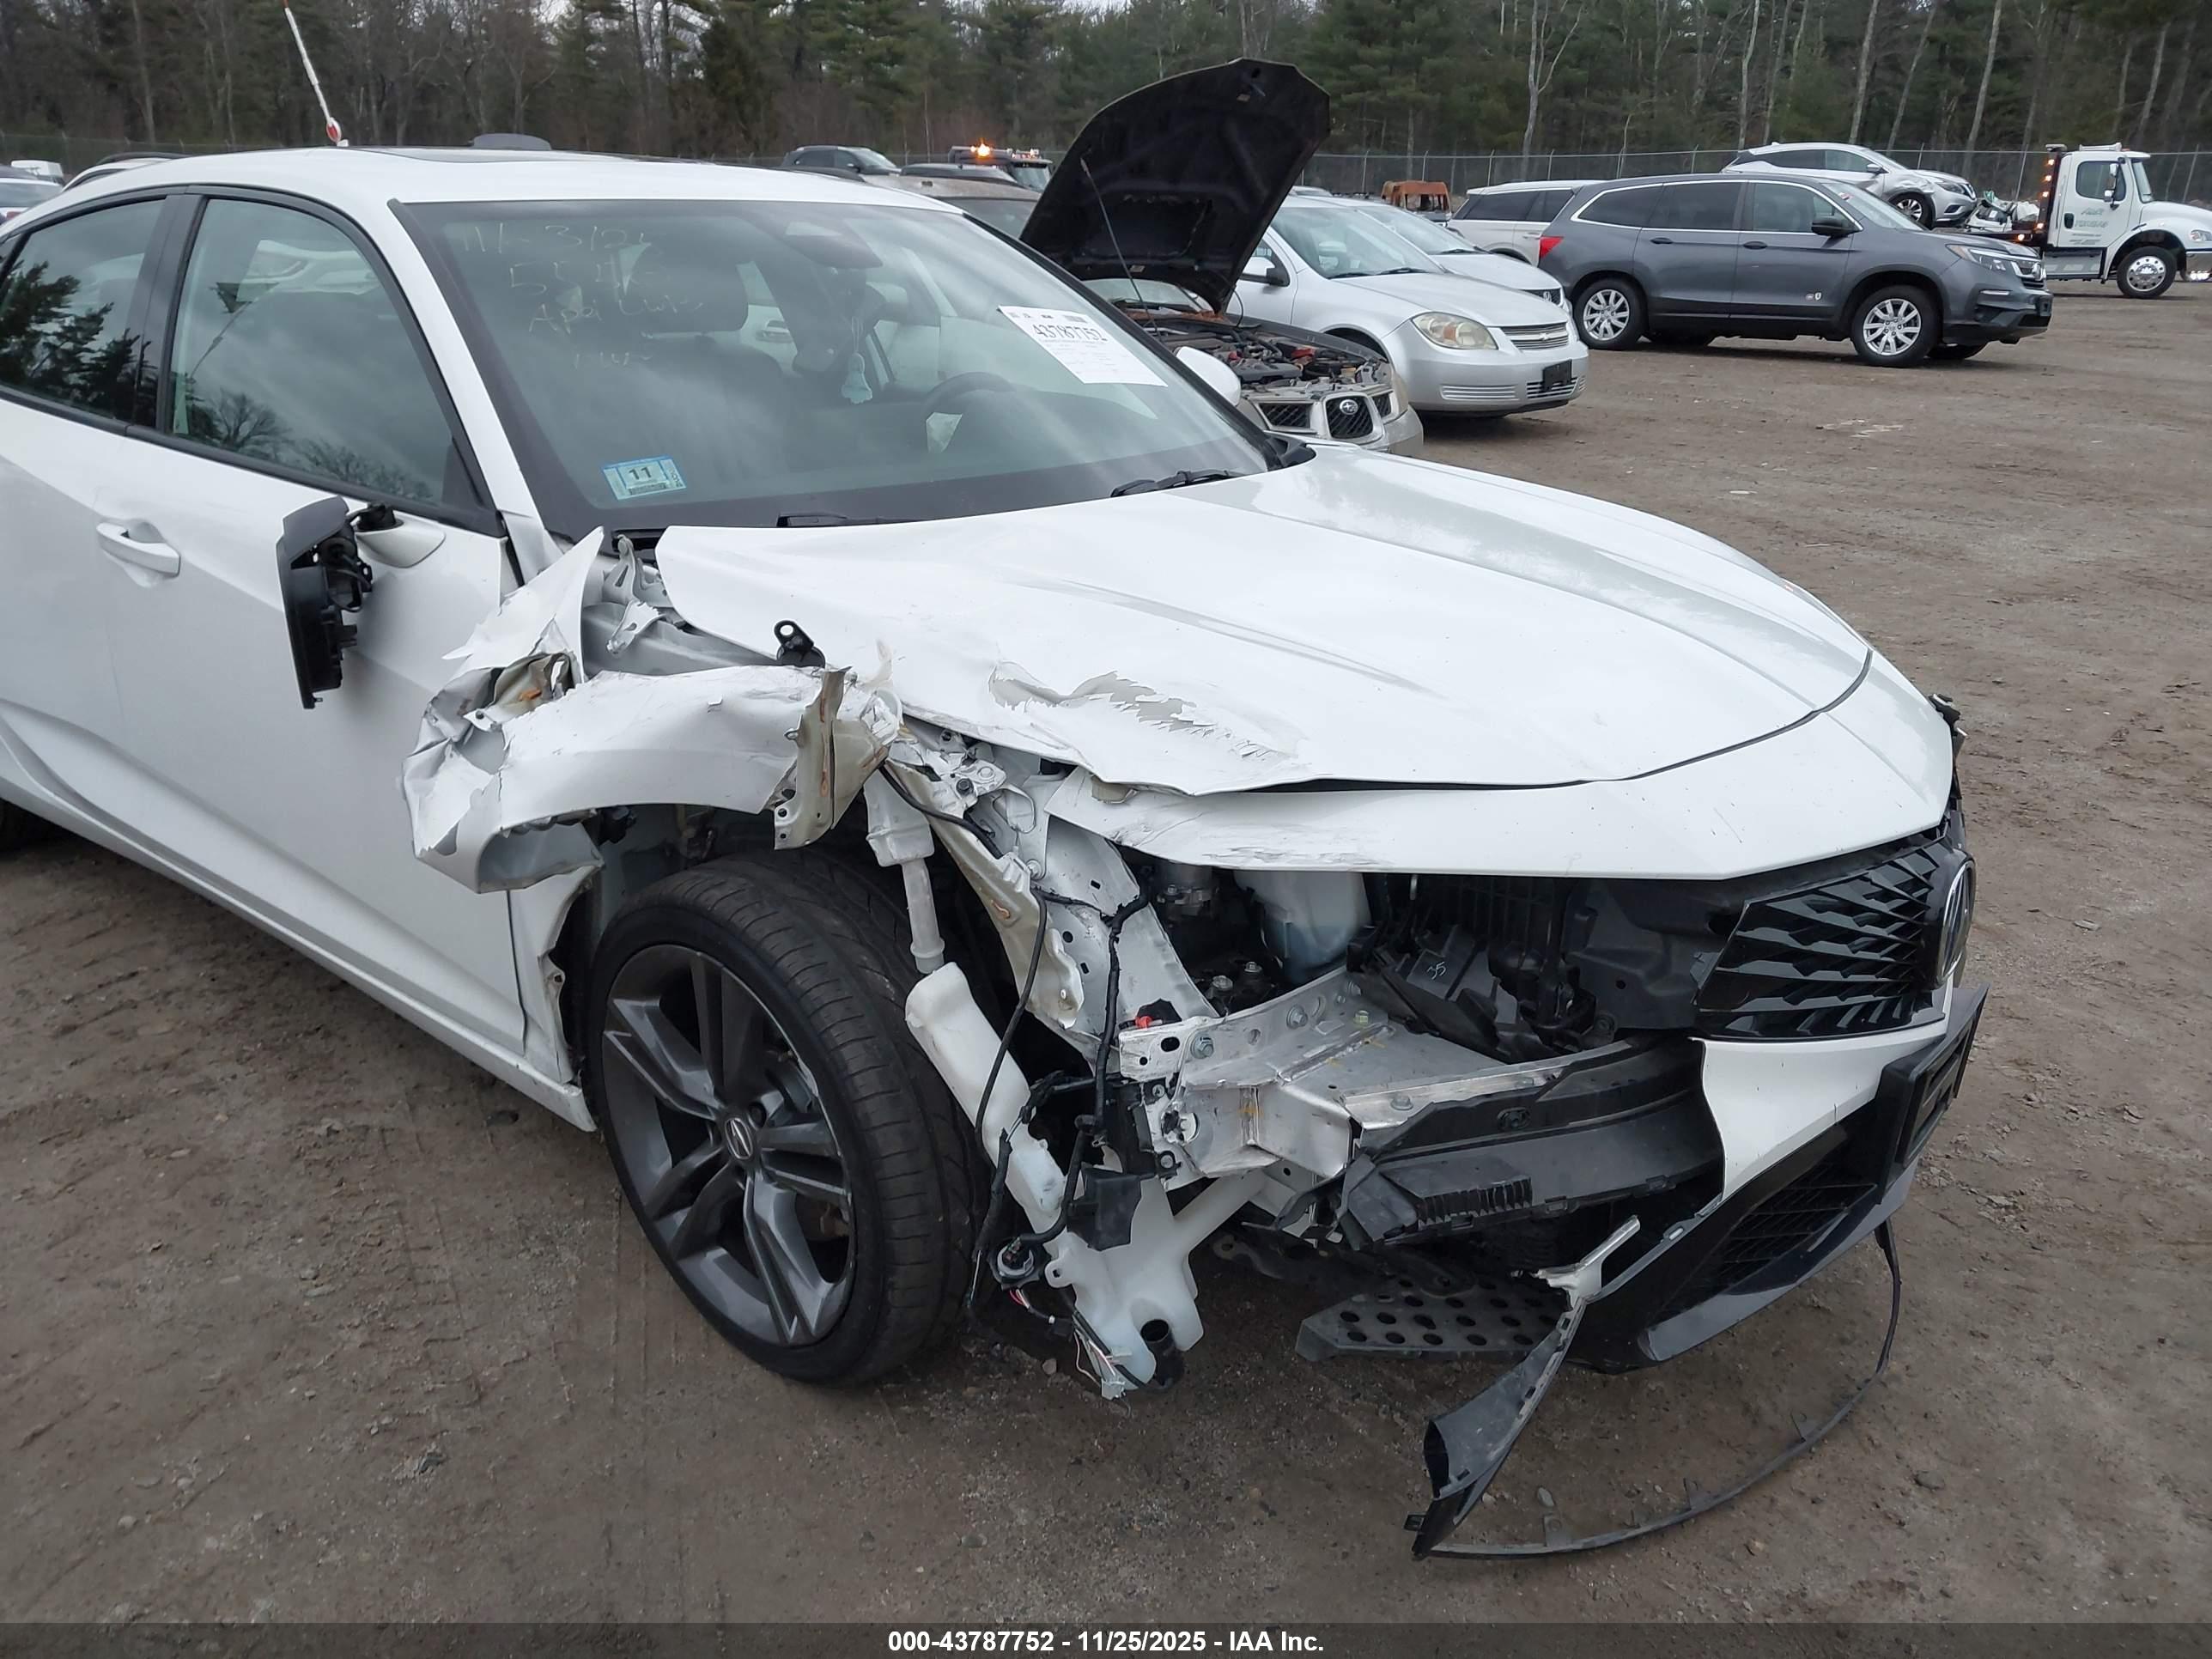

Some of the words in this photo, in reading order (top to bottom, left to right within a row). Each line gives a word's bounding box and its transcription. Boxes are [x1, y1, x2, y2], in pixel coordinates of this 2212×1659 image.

[1032, 323, 1108, 342] 43787752
[629, 466, 653, 481] 11
[1426, 961, 1447, 981] 35
